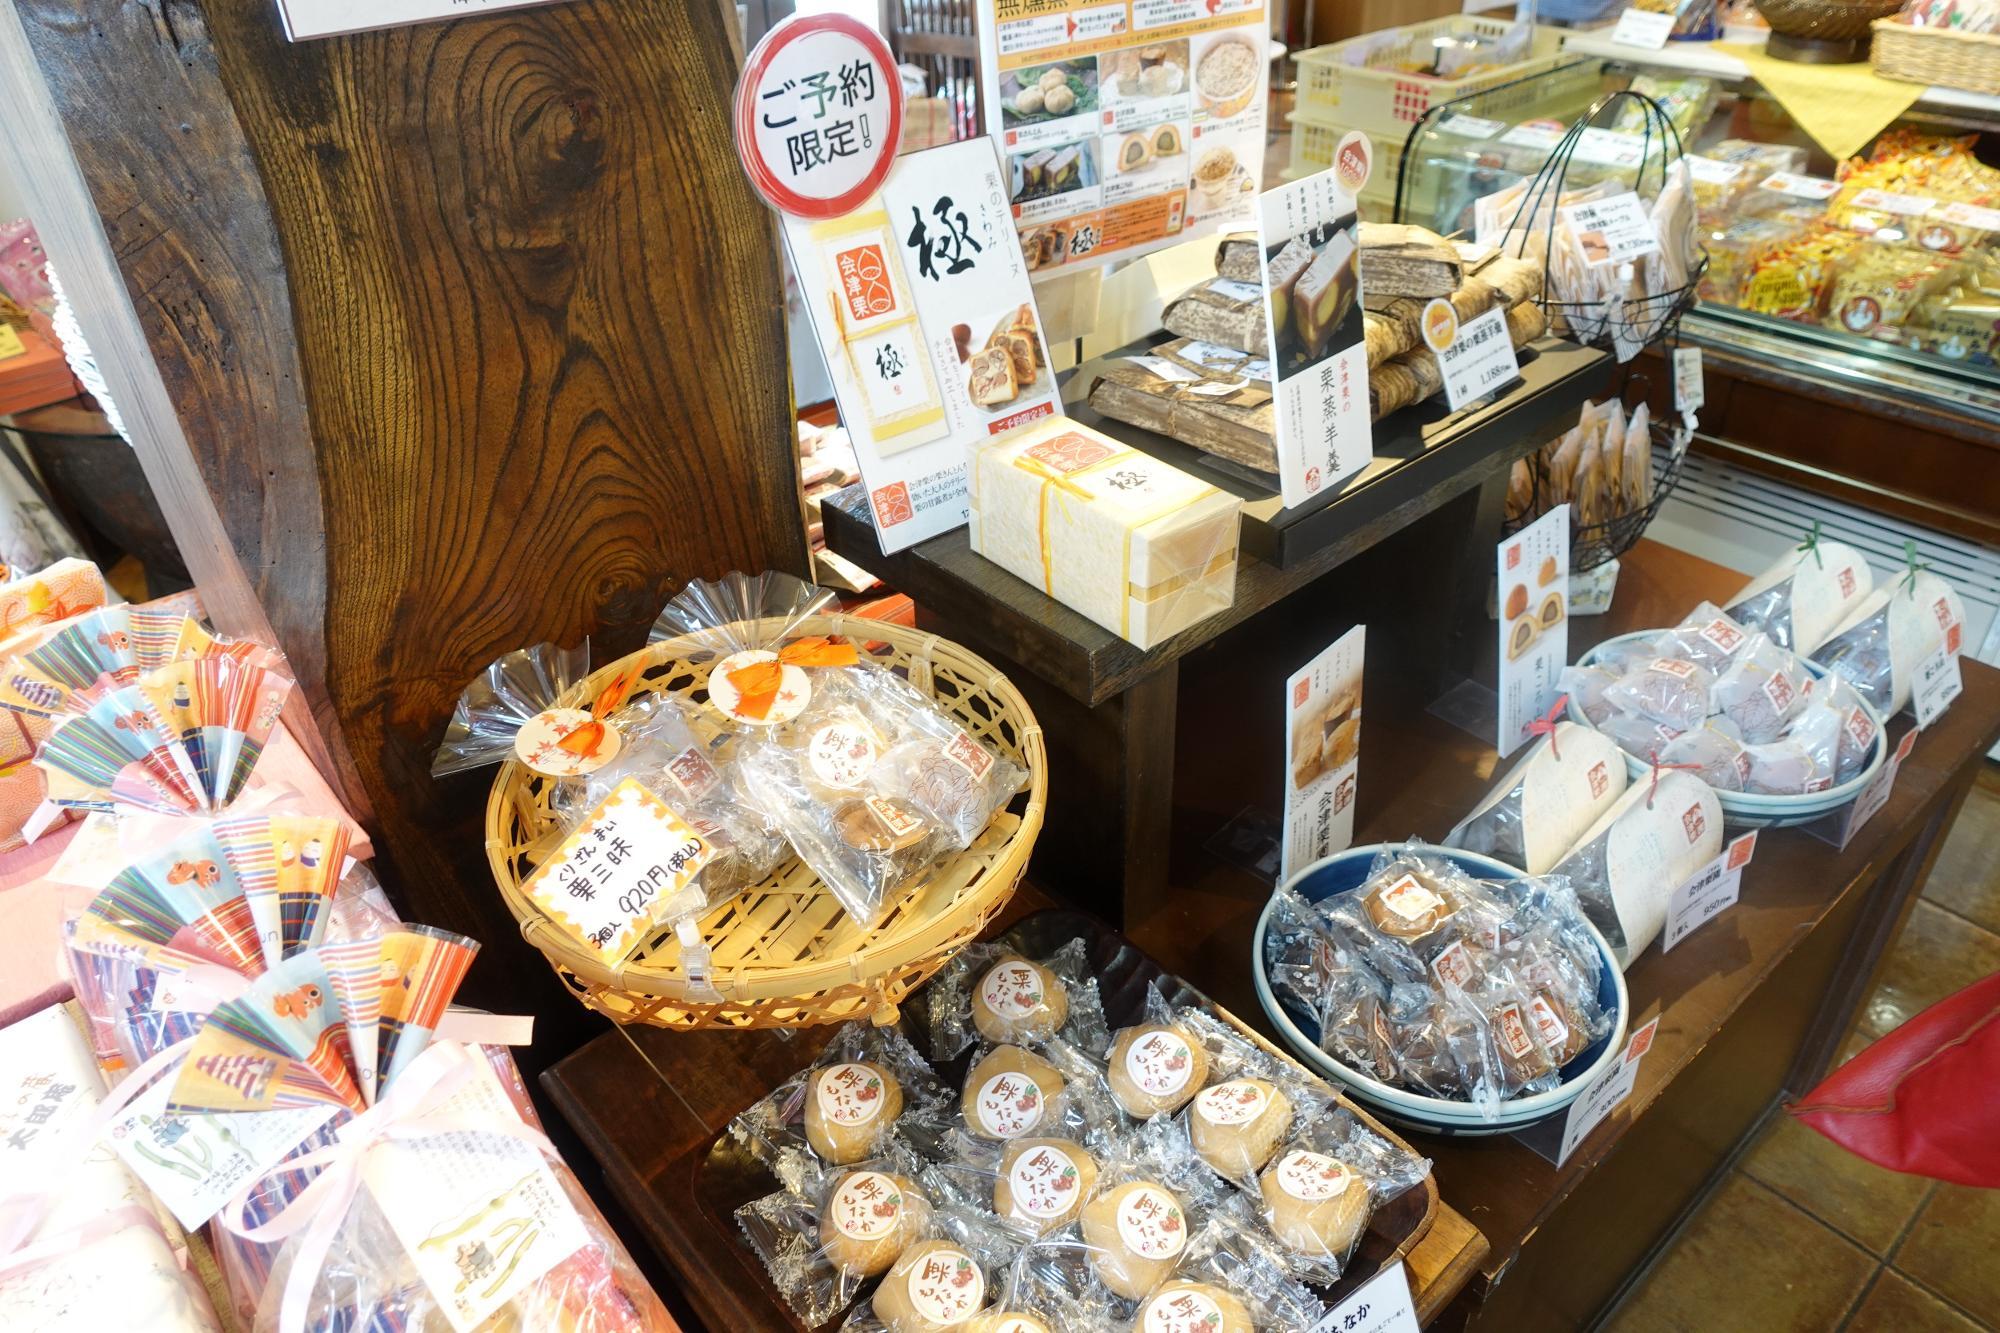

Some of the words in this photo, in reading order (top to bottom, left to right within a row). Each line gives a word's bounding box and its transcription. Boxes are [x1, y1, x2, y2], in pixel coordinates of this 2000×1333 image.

[762, 59, 875, 129] ご予約
[907, 196, 983, 282] 極
[980, 203, 997, 249] きわみ
[985, 171, 1019, 279] 栗のテリーヌ
[1070, 226, 1095, 256] 極
[840, 255, 870, 318] 会津栗
[875, 343, 904, 381] 極
[1320, 366, 1341, 477] 栗蒸羊羹
[1106, 471, 1148, 490] 極
[996, 971, 1013, 1009] もなか
[1011, 968, 1031, 988] 栗
[1143, 1035, 1169, 1059] 栗
[835, 1067, 863, 1091] 栗
[1135, 1055, 1170, 1088] もなか
[826, 1085, 862, 1119] もなか
[992, 1077, 1018, 1101] 栗
[1215, 1086, 1239, 1101] 栗
[985, 1099, 1024, 1133] もなか
[1029, 1149, 1060, 1178] 栗
[1294, 1155, 1321, 1172] 栗
[854, 1177, 884, 1201] 栗
[1021, 1170, 1058, 1209] もなか
[1286, 1170, 1329, 1195] もなか
[843, 1194, 876, 1233] もなか
[1134, 1192, 1162, 1220] 栗
[1127, 1216, 1169, 1251] もなか
[922, 1258, 952, 1282] 栗
[919, 1286, 969, 1310] もなか
[1170, 1294, 1202, 1318] 栗
